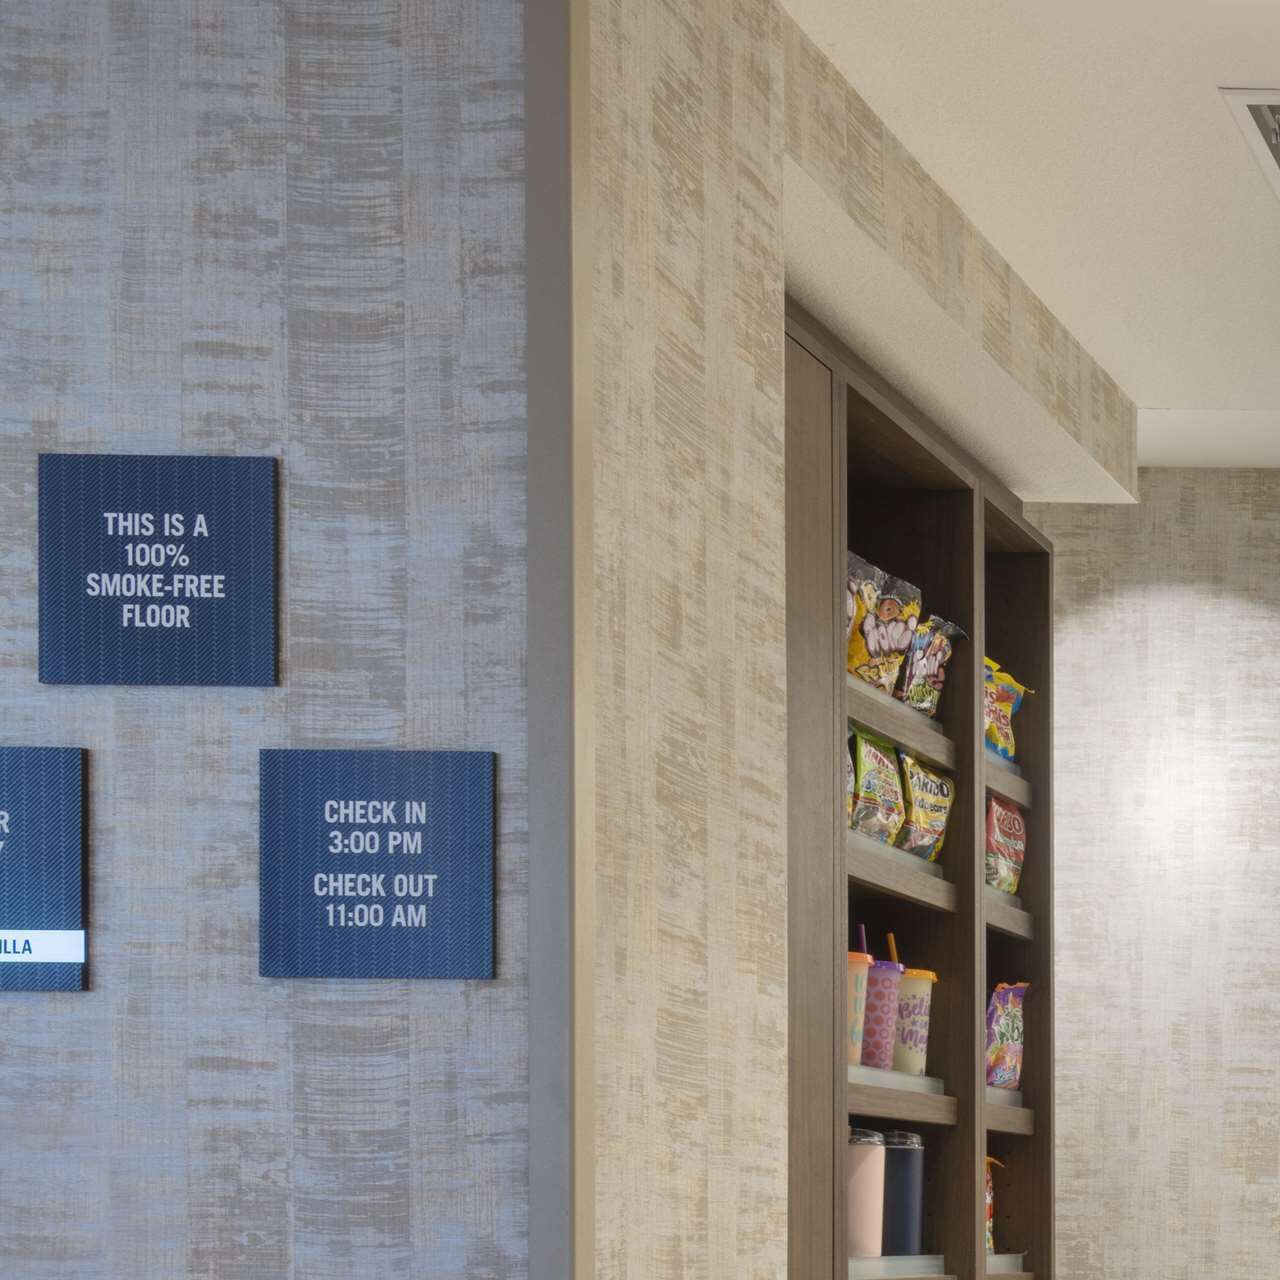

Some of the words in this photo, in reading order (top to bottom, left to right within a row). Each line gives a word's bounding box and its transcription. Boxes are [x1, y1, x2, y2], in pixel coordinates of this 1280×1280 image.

[104, 512, 155, 537] THIS
[163, 512, 184, 537] IS
[193, 513, 209, 537] A
[124, 543, 190, 567] 100%
[86, 573, 226, 598] SMOKE-FREE
[122, 604, 191, 628] FLOOR
[324, 800, 397, 824] CHECK
[405, 801, 427, 825] IN
[329, 830, 382, 854] 3:00
[389, 831, 422, 855] PM
[314, 873, 387, 898] CHECK
[394, 874, 438, 898] OUT
[325, 904, 386, 927] 11:00
[391, 905, 427, 928] AM
